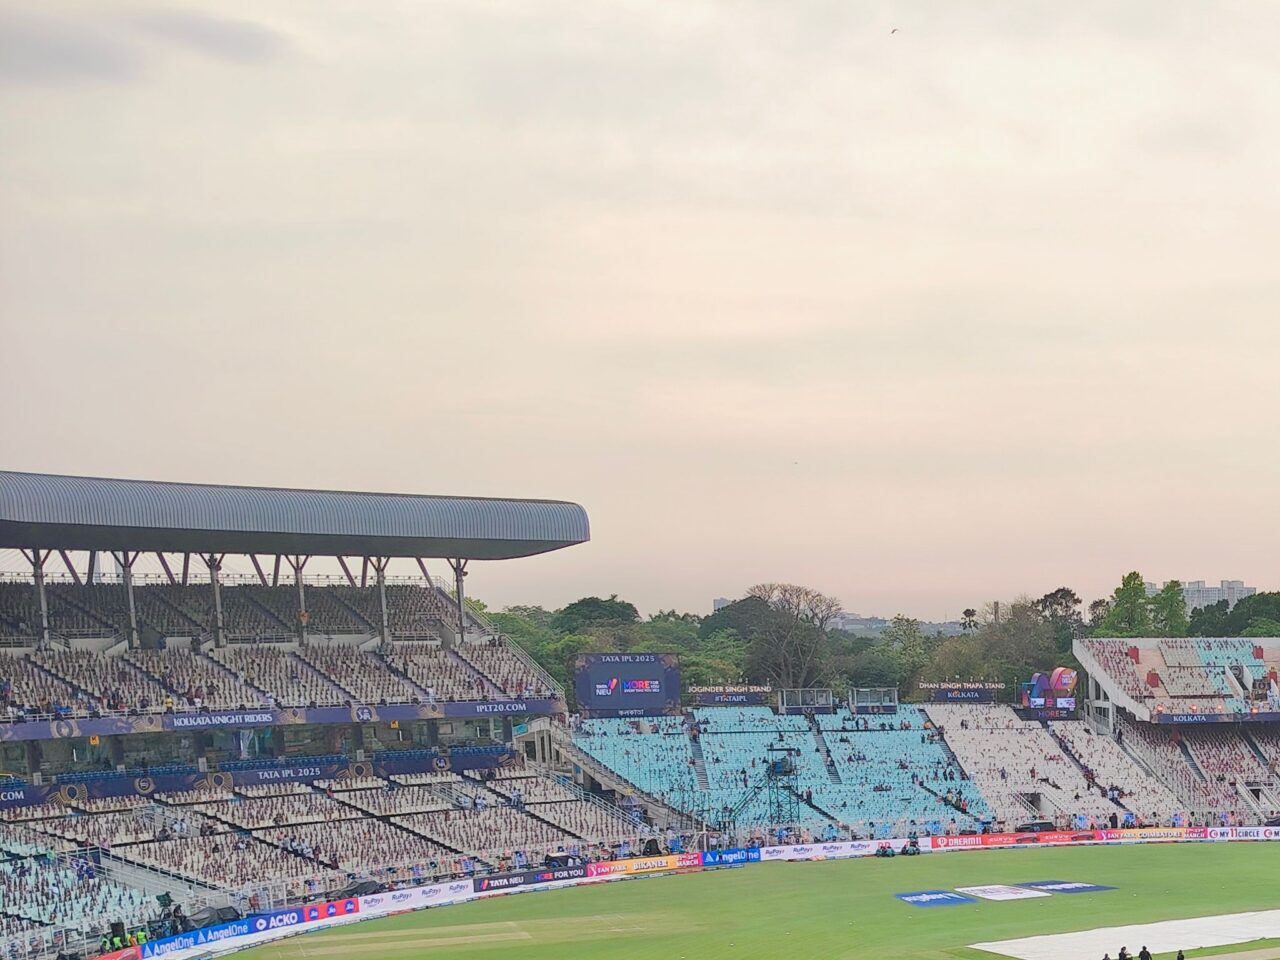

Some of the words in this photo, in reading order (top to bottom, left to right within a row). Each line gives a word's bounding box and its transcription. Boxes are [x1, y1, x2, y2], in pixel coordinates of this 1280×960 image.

[623, 680, 650, 689] MORE
[688, 685, 724, 694] JOGINDER
[725, 685, 748, 693] SINGH
[749, 685, 772, 693] STAND
[595, 688, 612, 696] NEU
[947, 691, 980, 699] KOLKATA
[476, 703, 527, 713] IPLT20.COM
[173, 716, 211, 727] KOLKATA
[211, 714, 244, 725] KNIGHT
[244, 713, 273, 723] RIDERS
[1173, 714, 1206, 723] KOLKATA
[257, 770, 280, 779] TATA
[281, 769, 296, 778] IPL
[297, 767, 321, 778] 2025
[948, 836, 982, 845] DREAM11
[633, 860, 669, 870] BIKANER
[676, 859, 699, 867] MARCH
[490, 879, 509, 887] TATA
[509, 876, 524, 884] NEU
[554, 870, 568, 879] FOR
[568, 869, 584, 877] YOU
[269, 912, 298, 928] ACKO
[207, 923, 248, 941] AngelOne
[153, 936, 195, 955] AngelOne
